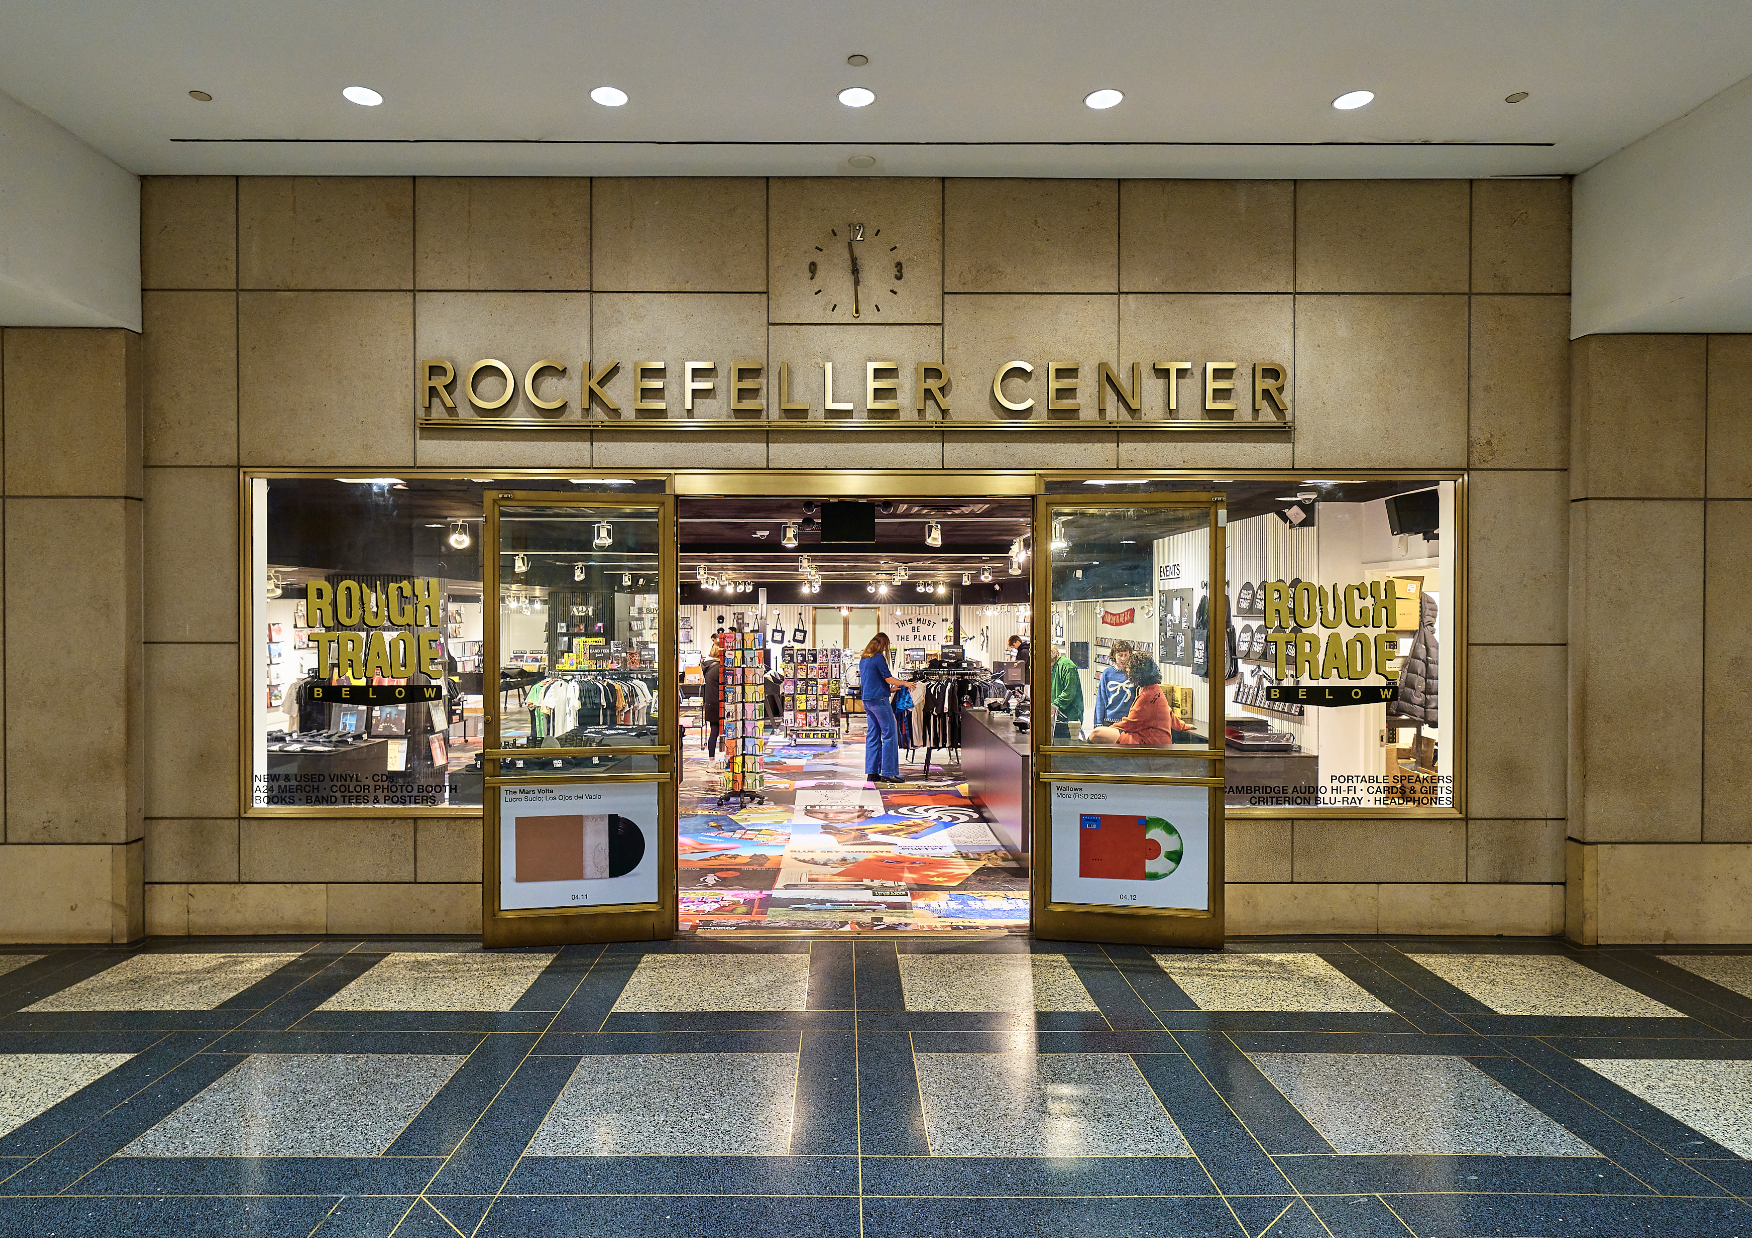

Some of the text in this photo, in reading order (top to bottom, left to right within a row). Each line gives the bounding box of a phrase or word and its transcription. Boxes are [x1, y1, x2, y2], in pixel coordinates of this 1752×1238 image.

[848, 223, 864, 241] 12
[808, 261, 817, 280] 9
[894, 261, 903, 280] 3
[421, 358, 1288, 411] ROCKEFELLER CENTER
[1159, 564, 1181, 578] EVENTS
[306, 578, 440, 628] ROUGH
[1263, 580, 1397, 630] ROUGH
[896, 617, 937, 628] THIS MUST
[308, 631, 443, 680] TRADE
[1267, 632, 1400, 680] TRADE
[314, 687, 437, 698] BELOW
[1270, 688, 1393, 699] BELOW
[254, 774, 394, 783] NEW & USED VINYL CDs
[1330, 775, 1452, 784] PORTABLE SPEAKERS
[254, 785, 458, 794] A24 MERCH COLOR PHOTO BOOTH
[1291, 786, 1327, 795] AUDIO
[1331, 786, 1356, 795] HI-FI
[1366, 786, 1406, 795] CARDS
[1409, 786, 1417, 795] &
[1420, 786, 1452, 795] GIFTS
[254, 795, 436, 804] BOOKS BAND TEES & POSTERS
[1249, 796, 1452, 806] CRITERION BLU-RAY HEADPHONES
